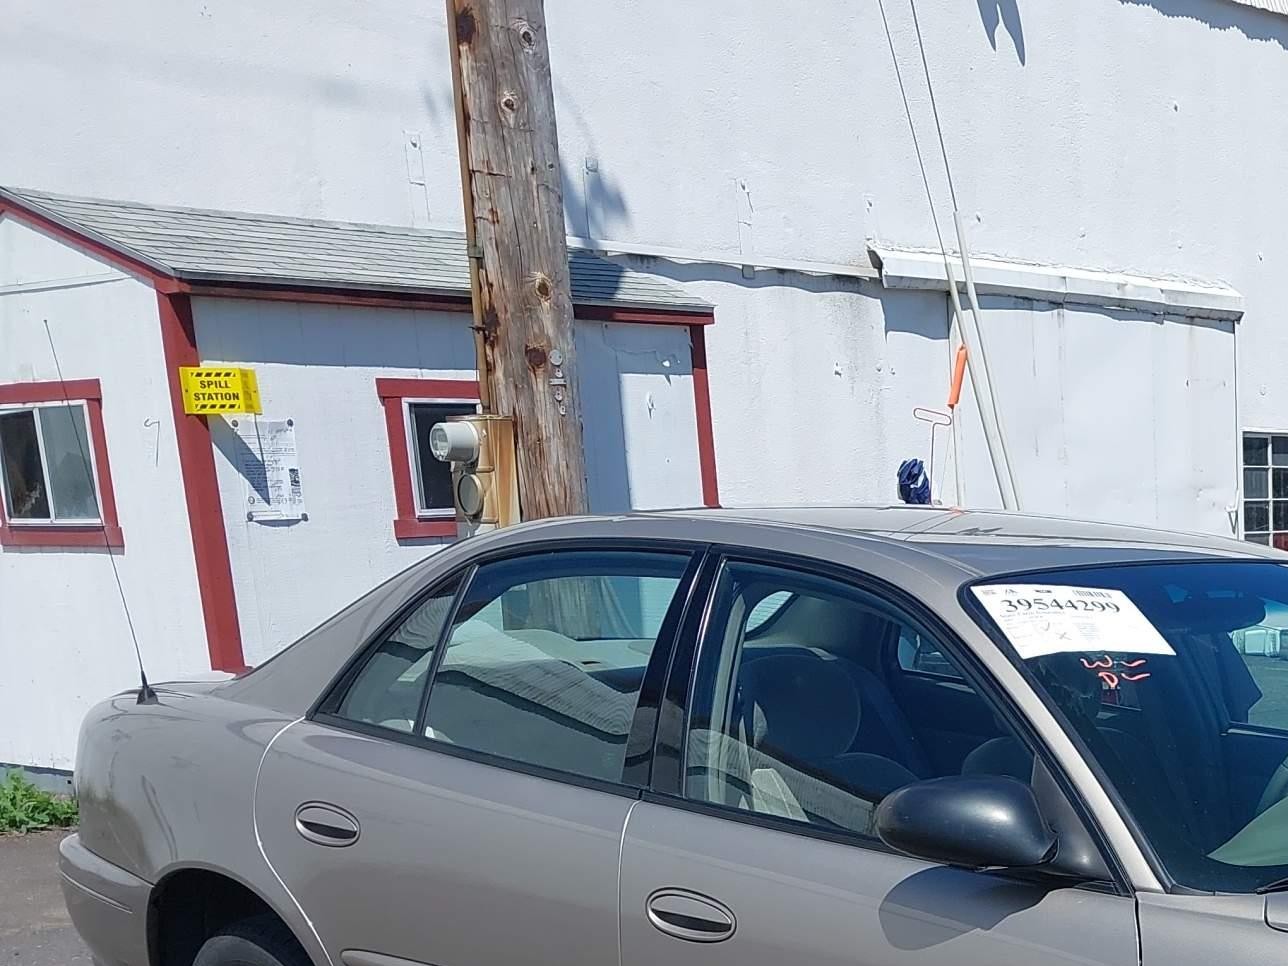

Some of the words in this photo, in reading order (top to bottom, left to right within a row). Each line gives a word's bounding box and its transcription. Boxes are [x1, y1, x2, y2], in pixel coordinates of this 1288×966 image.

[199, 380, 231, 389] SPILL
[193, 392, 240, 401] STATION
[1001, 598, 1120, 613] 39544299
